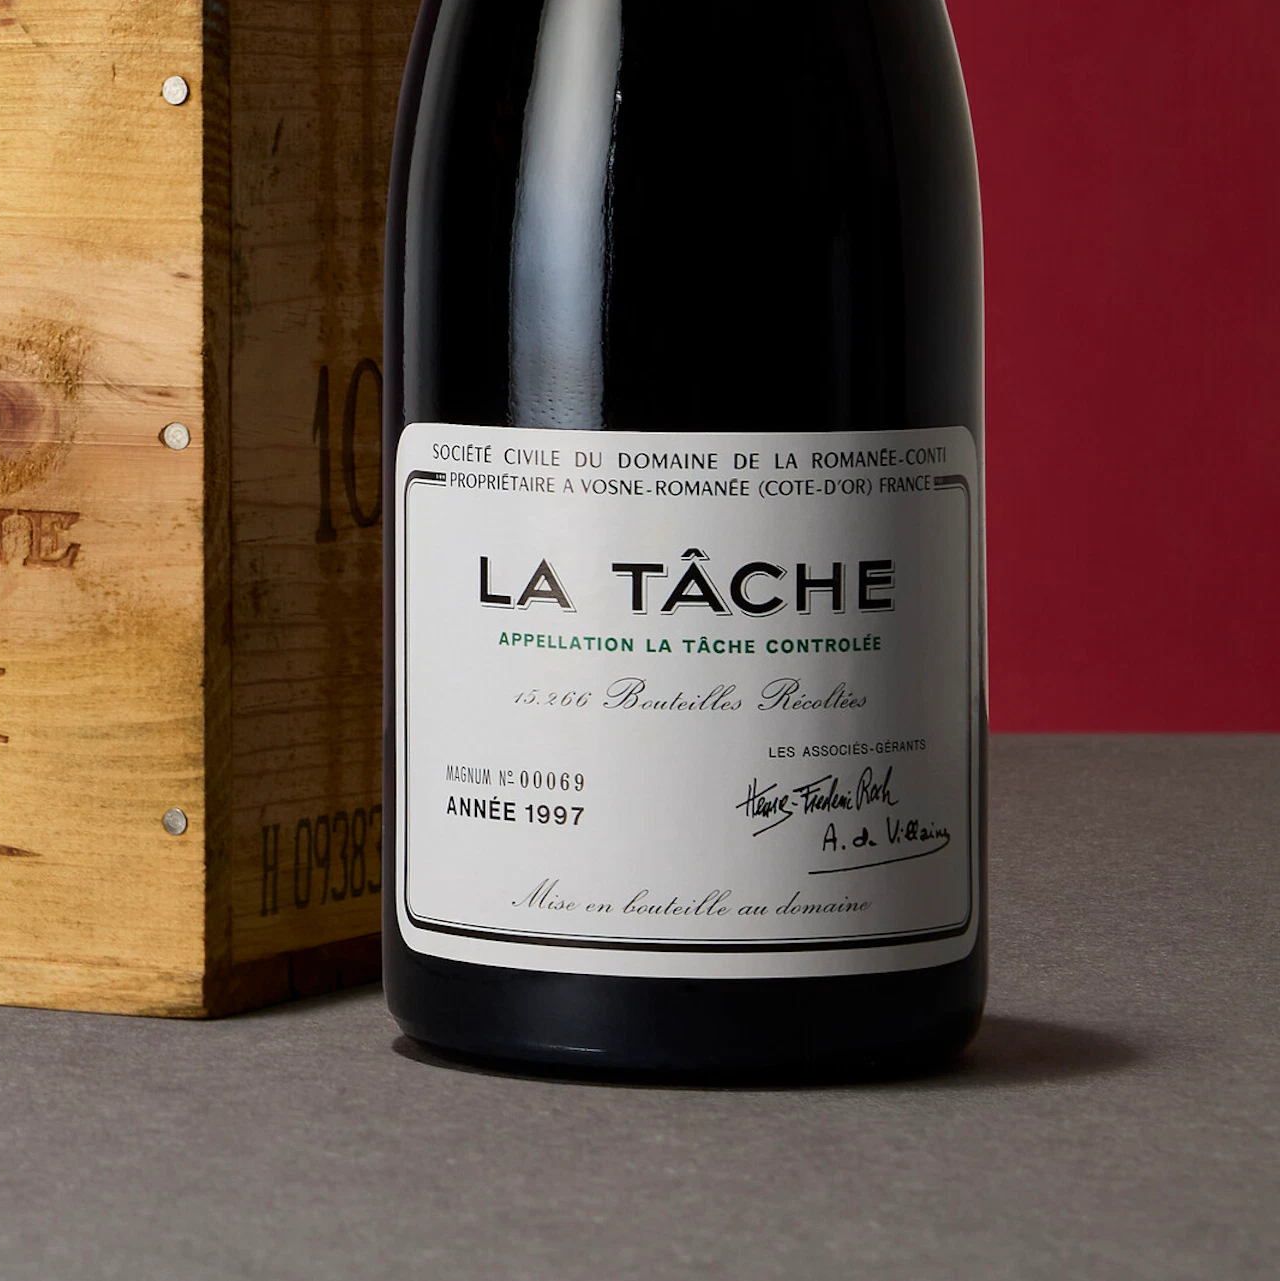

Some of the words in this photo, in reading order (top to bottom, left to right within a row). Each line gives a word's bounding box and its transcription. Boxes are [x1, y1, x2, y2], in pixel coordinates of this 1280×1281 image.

[432, 442, 492, 465] SOCIÉTÉ
[504, 448, 560, 467] CIVILE
[575, 450, 602, 469] DU
[618, 452, 718, 470] DOMAINE
[734, 452, 760, 470] DE
[774, 451, 797, 469] LA
[811, 445, 947, 468] ROMANÉE-CONTI
[450, 471, 555, 493] PROPRIÉTAIRE
[562, 476, 574, 494] A
[581, 478, 750, 496] VOSNE-ROMANÉE
[758, 477, 872, 499] (COTE-D'OR)
[879, 474, 931, 493] FRANCE
[479, 555, 577, 613] LA
[612, 547, 897, 616] TÂCHE
[498, 631, 634, 652] APPELLATION
[646, 636, 672, 653] LA
[683, 634, 755, 654] TÂCHE
[766, 633, 882, 653] CONTROLÉE
[603, 677, 743, 711] Bouteilles
[757, 677, 867, 711] Récoltées
[769, 746, 797, 757] LES
[802, 739, 926, 756] ASSOCIÉS-GÉRANTS
[446, 764, 492, 786] MAGNUM
[519, 770, 585, 791] 00069
[446, 796, 517, 822] ANNÉE
[525, 804, 585, 826] 1997
[261, 824, 280, 917] H
[512, 878, 581, 911] Mise
[587, 901, 614, 913] en
[621, 888, 732, 917] bouteille
[738, 904, 769, 916] au
[776, 889, 872, 915] domaine
